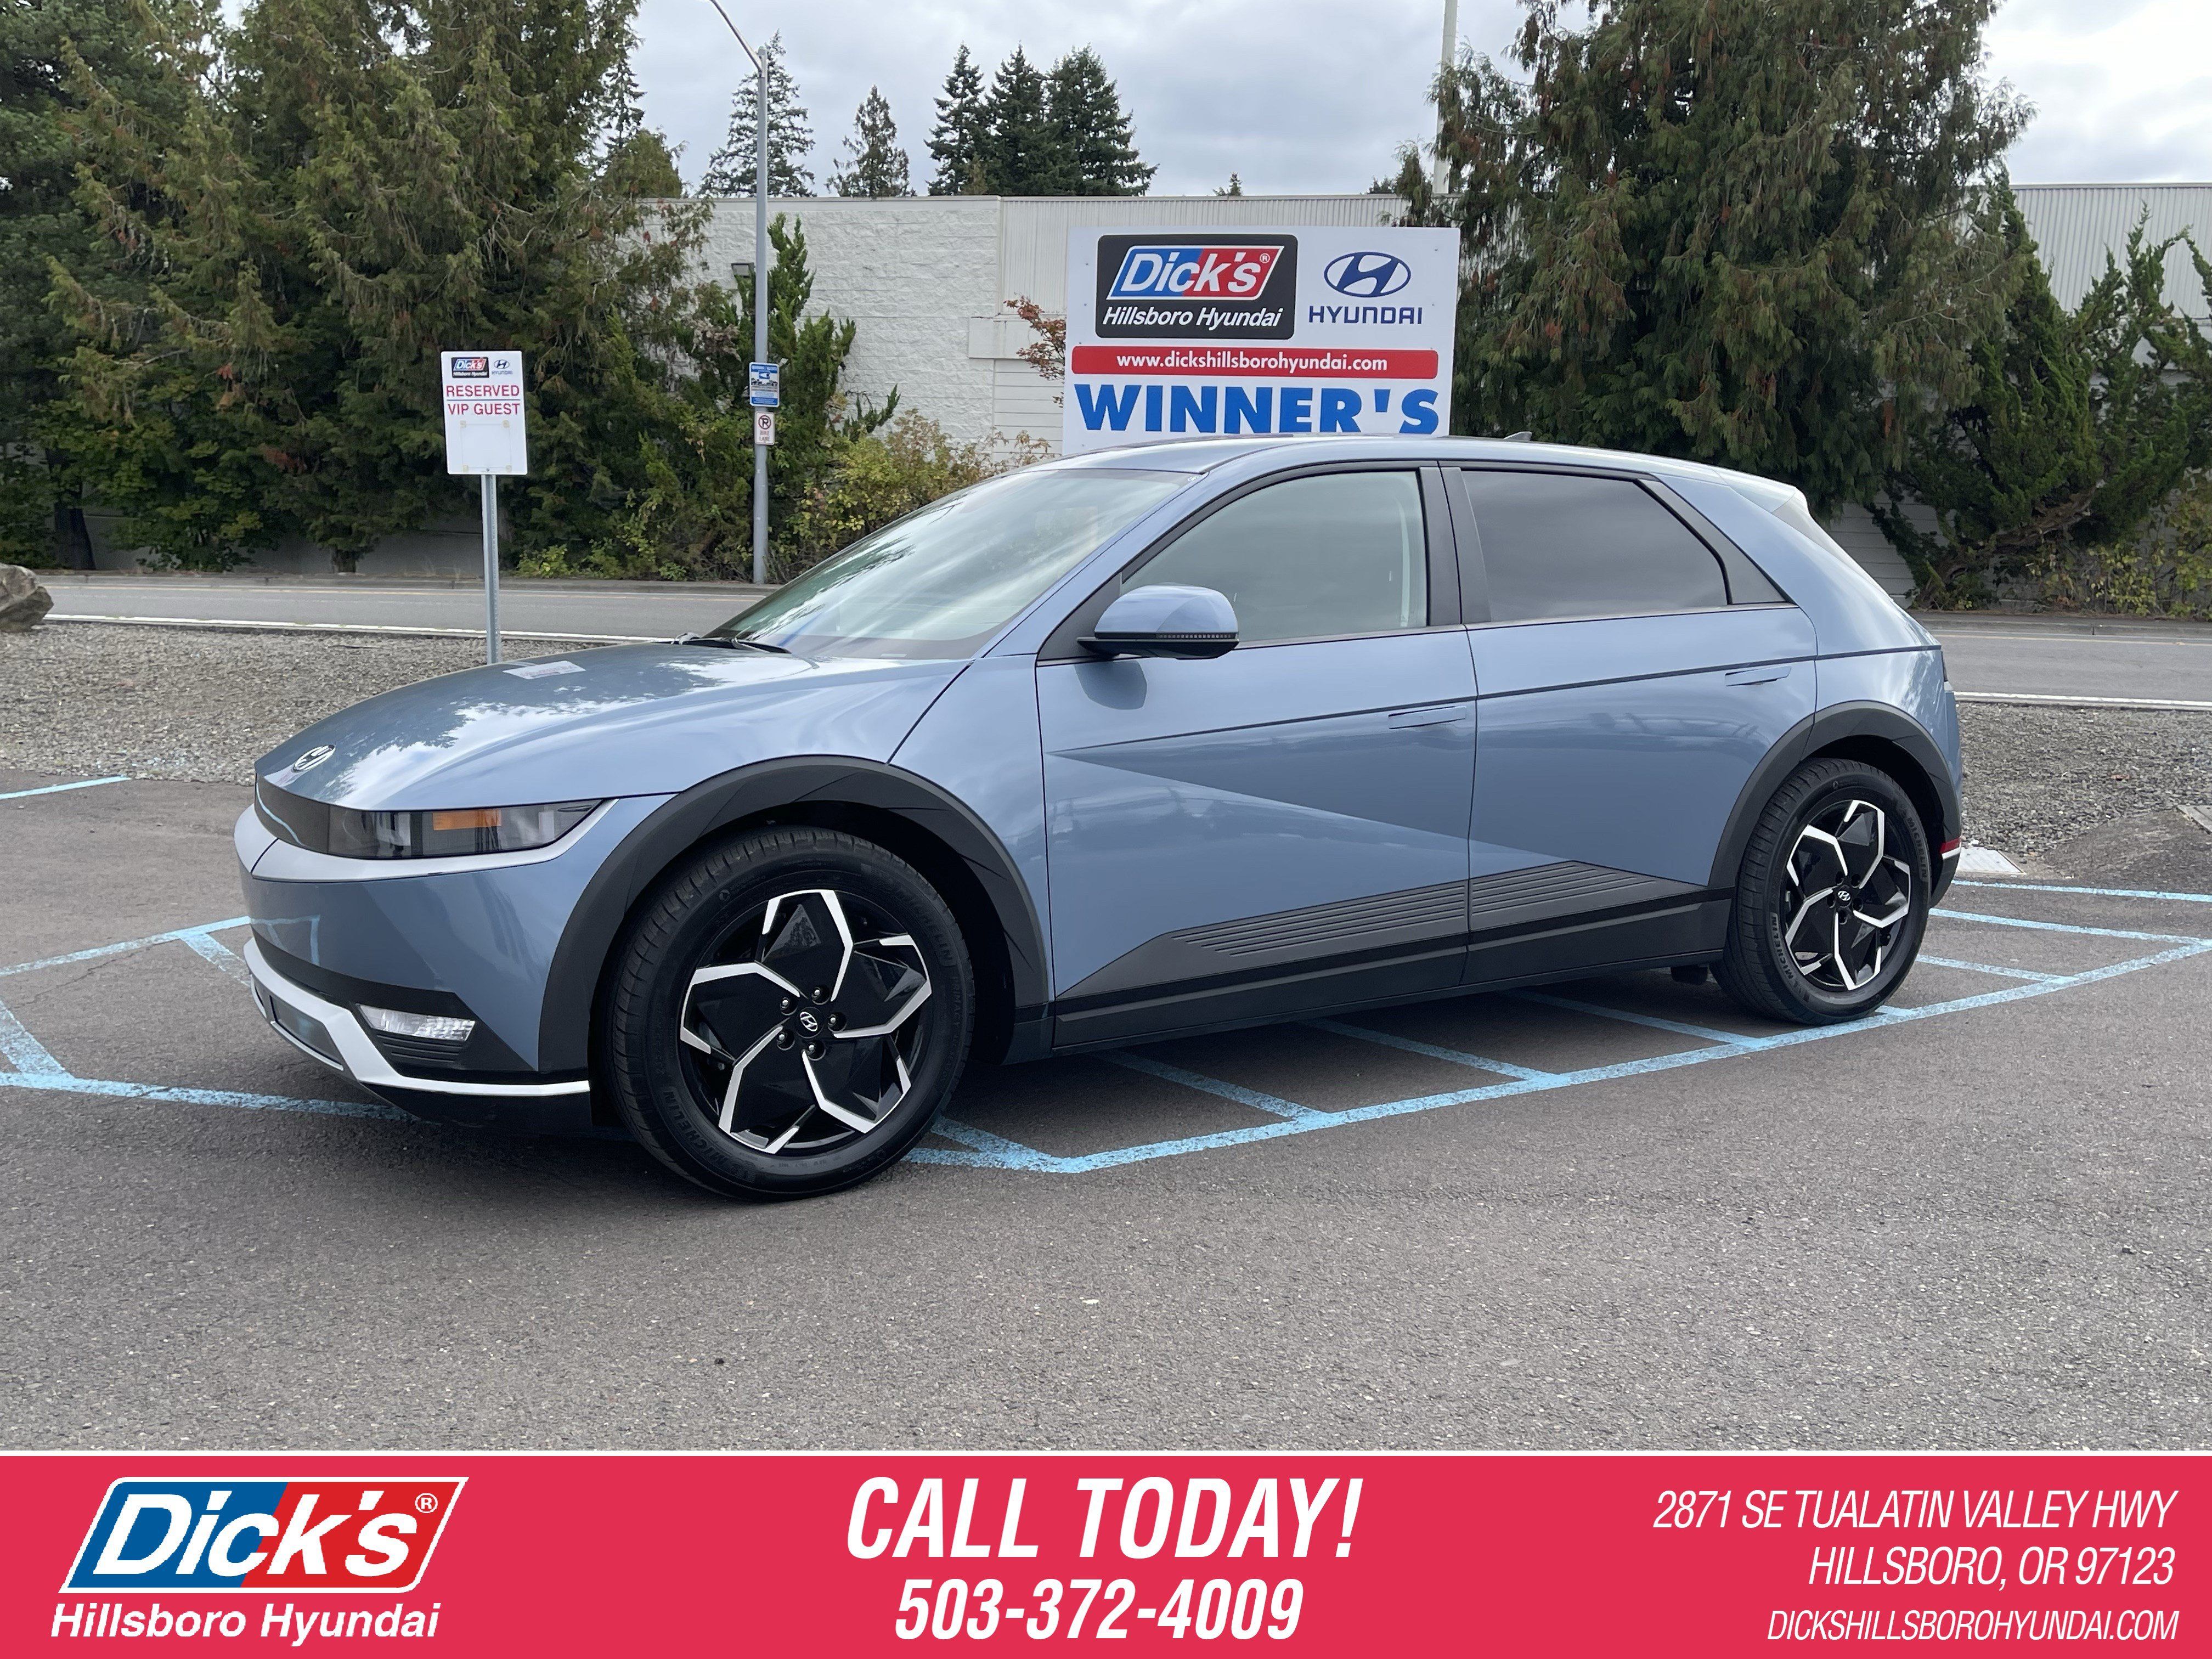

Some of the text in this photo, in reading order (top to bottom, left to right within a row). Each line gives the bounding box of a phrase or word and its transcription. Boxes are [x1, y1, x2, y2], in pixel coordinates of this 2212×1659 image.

[1120, 252, 1261, 292] Dick's
[1102, 306, 1284, 331] Hillsboro Hyundai
[1308, 306, 1423, 325] HYUNDAI
[1116, 351, 1388, 374] www.dickshillsborohyundai.com
[446, 385, 520, 397] RESERVED
[448, 403, 520, 415] VIP GUEST
[1074, 383, 1440, 435] WINNER'S
[1771, 916, 1794, 979] MICHELIN
[663, 1091, 730, 1165] MICHELIN
